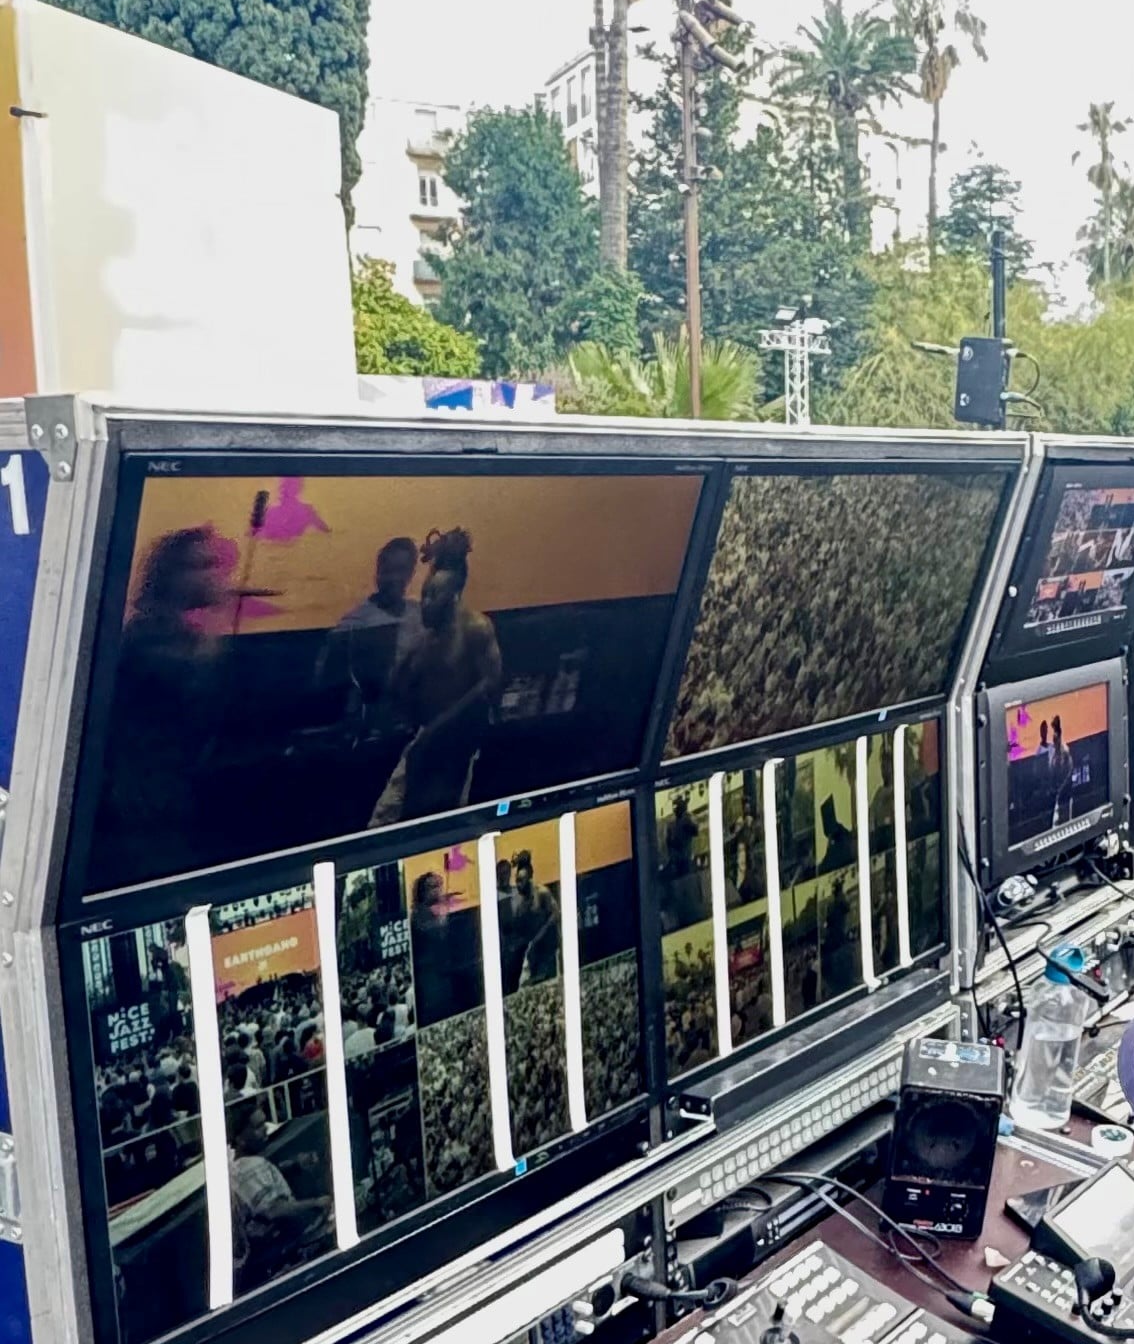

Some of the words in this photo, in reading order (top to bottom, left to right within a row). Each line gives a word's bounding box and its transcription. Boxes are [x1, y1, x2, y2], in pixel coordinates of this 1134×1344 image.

[148, 461, 182, 472] NEC
[1, 454, 30, 535] 1
[80, 918, 113, 935] NEC
[109, 1016, 153, 1040] JAZZ
